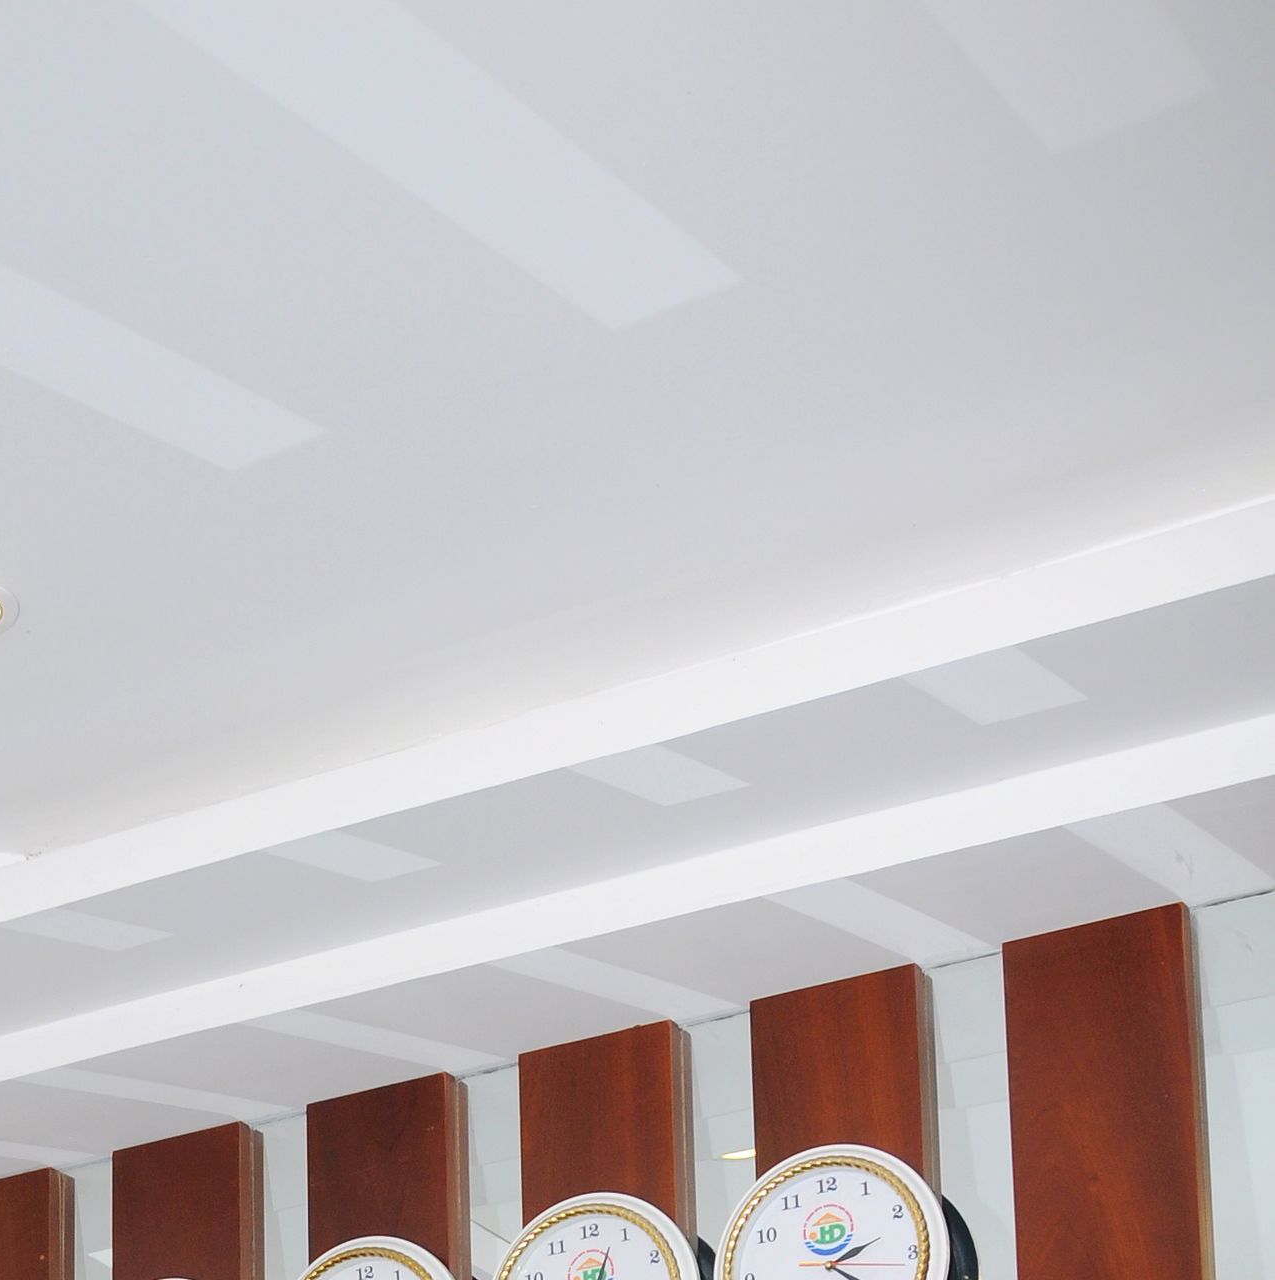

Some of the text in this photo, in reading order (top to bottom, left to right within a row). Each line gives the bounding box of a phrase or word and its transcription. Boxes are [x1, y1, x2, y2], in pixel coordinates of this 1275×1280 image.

[817, 1177, 837, 1193] 12
[861, 1182, 870, 1196] 1
[782, 1195, 802, 1211] 11
[893, 1205, 903, 1219] 2
[580, 1224, 599, 1239] 12
[621, 1228, 629, 1242] 1
[757, 1228, 777, 1244] 10
[548, 1240, 565, 1255] 11
[908, 1245, 918, 1259] 3
[650, 1250, 660, 1263] 2
[356, 1266, 374, 1280] 12
